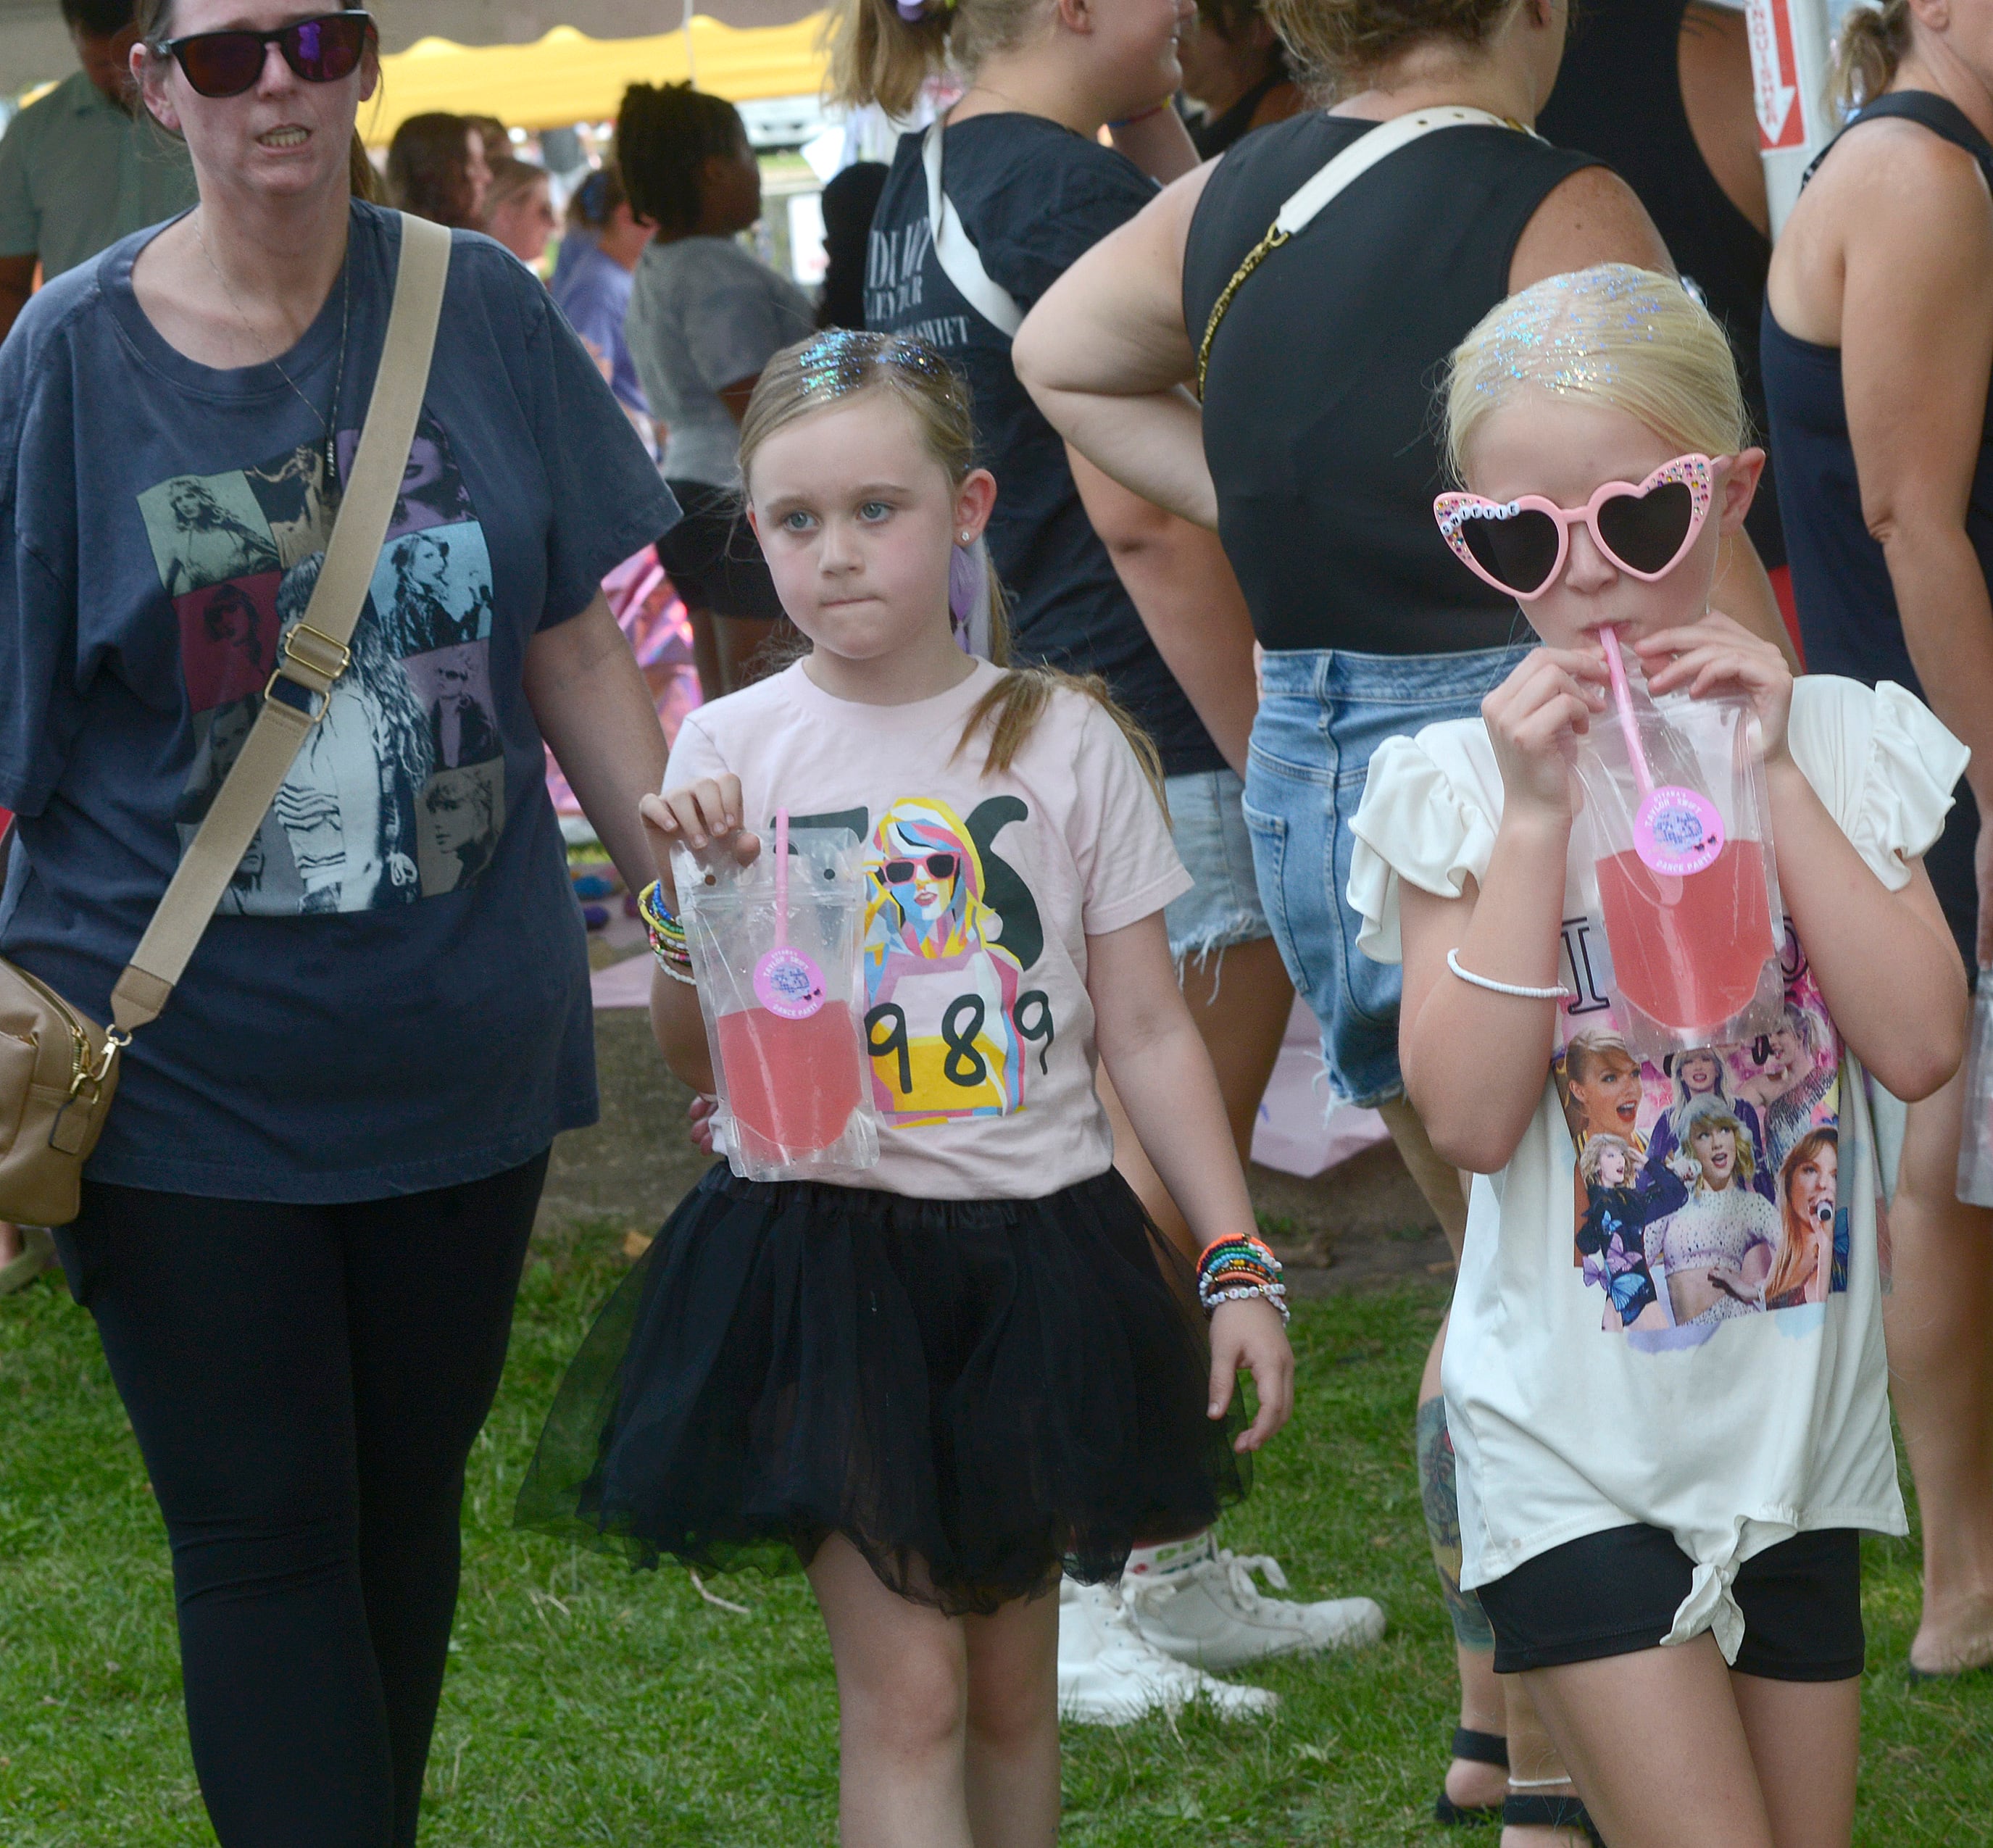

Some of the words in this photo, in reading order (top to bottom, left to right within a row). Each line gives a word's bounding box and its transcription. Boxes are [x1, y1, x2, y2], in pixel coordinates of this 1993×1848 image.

[1442, 504, 1517, 534] SWIFTIE
[1644, 799, 1670, 827] TAYLOR
[1677, 798, 1702, 813] SWIFT
[1656, 859, 1684, 872] DANCE
[1687, 852, 1713, 870] PARTY
[762, 957, 785, 977] TAYLOR
[790, 956, 810, 970] SWIFT
[773, 1003, 796, 1016] DANCE
[799, 1002, 818, 1016] PARTY
[864, 990, 1054, 1094] 989
